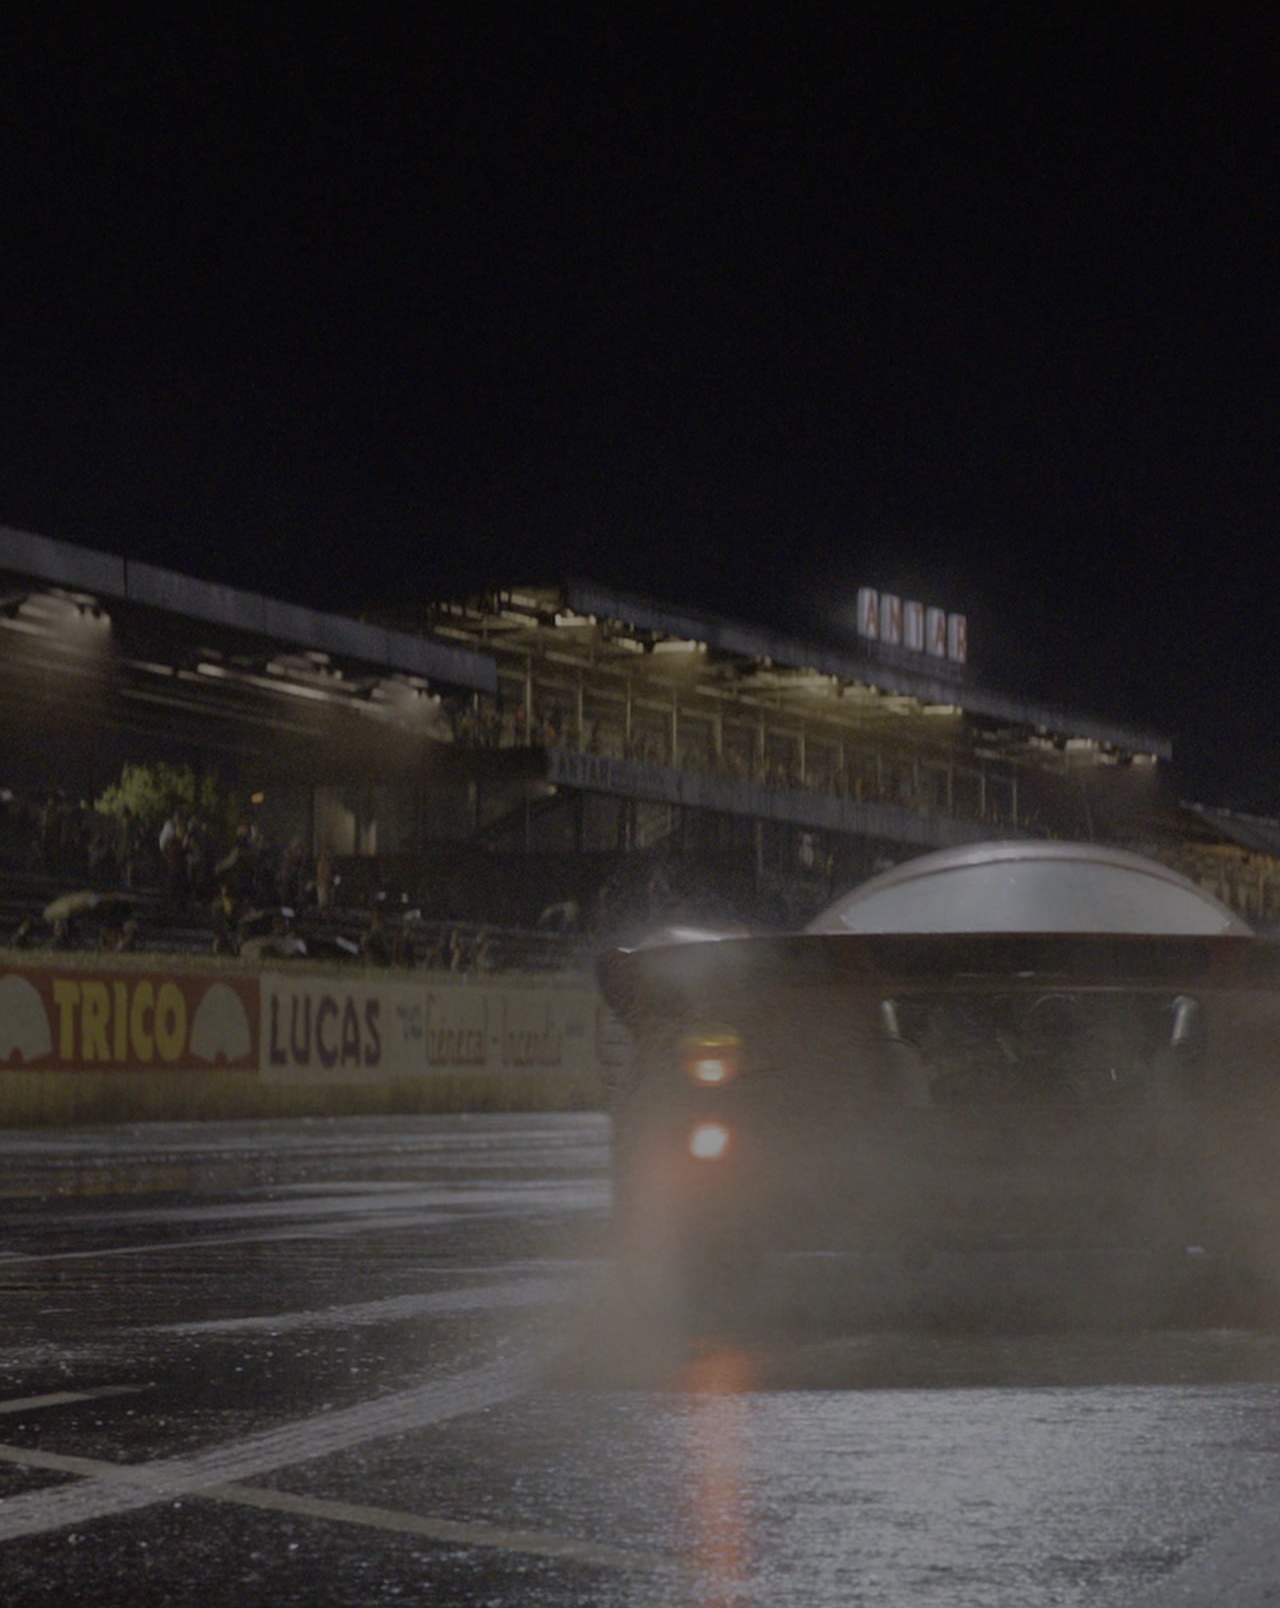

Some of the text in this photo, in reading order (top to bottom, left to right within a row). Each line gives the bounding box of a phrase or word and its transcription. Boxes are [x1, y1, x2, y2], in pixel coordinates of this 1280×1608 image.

[858, 588, 968, 665] ANTAR
[52, 978, 187, 1063] TRICO
[268, 993, 382, 1068] LUCAS
